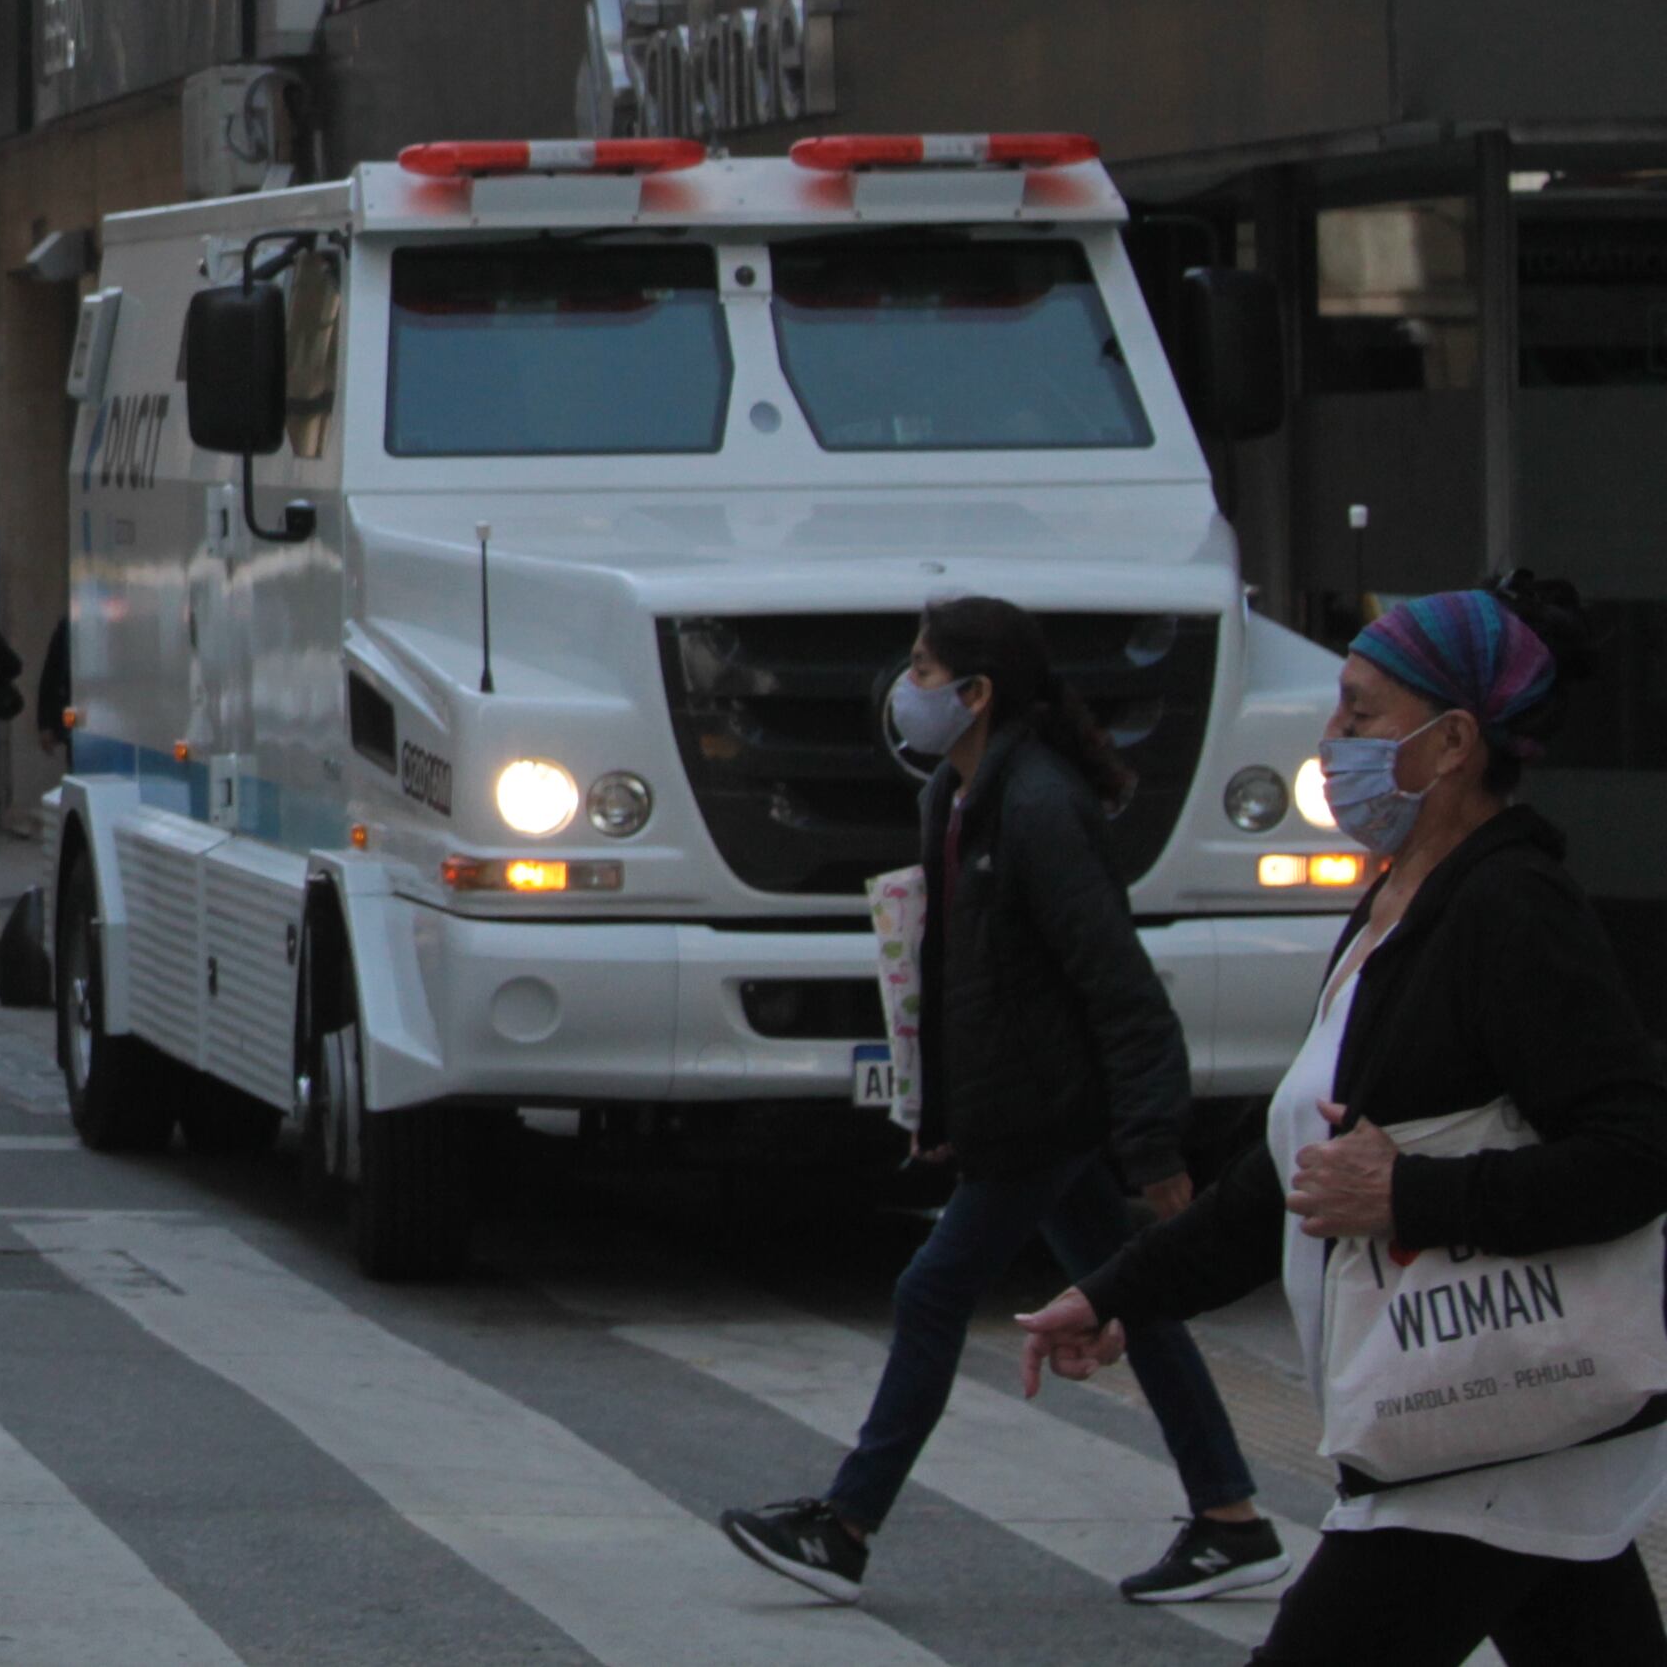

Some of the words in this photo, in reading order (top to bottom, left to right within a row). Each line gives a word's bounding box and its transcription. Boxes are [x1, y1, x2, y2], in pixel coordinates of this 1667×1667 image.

[1388, 1264, 1565, 1352] WOMAN
[1374, 1386, 1459, 1419] RIVAROLA
[1462, 1377, 1498, 1402] 520
